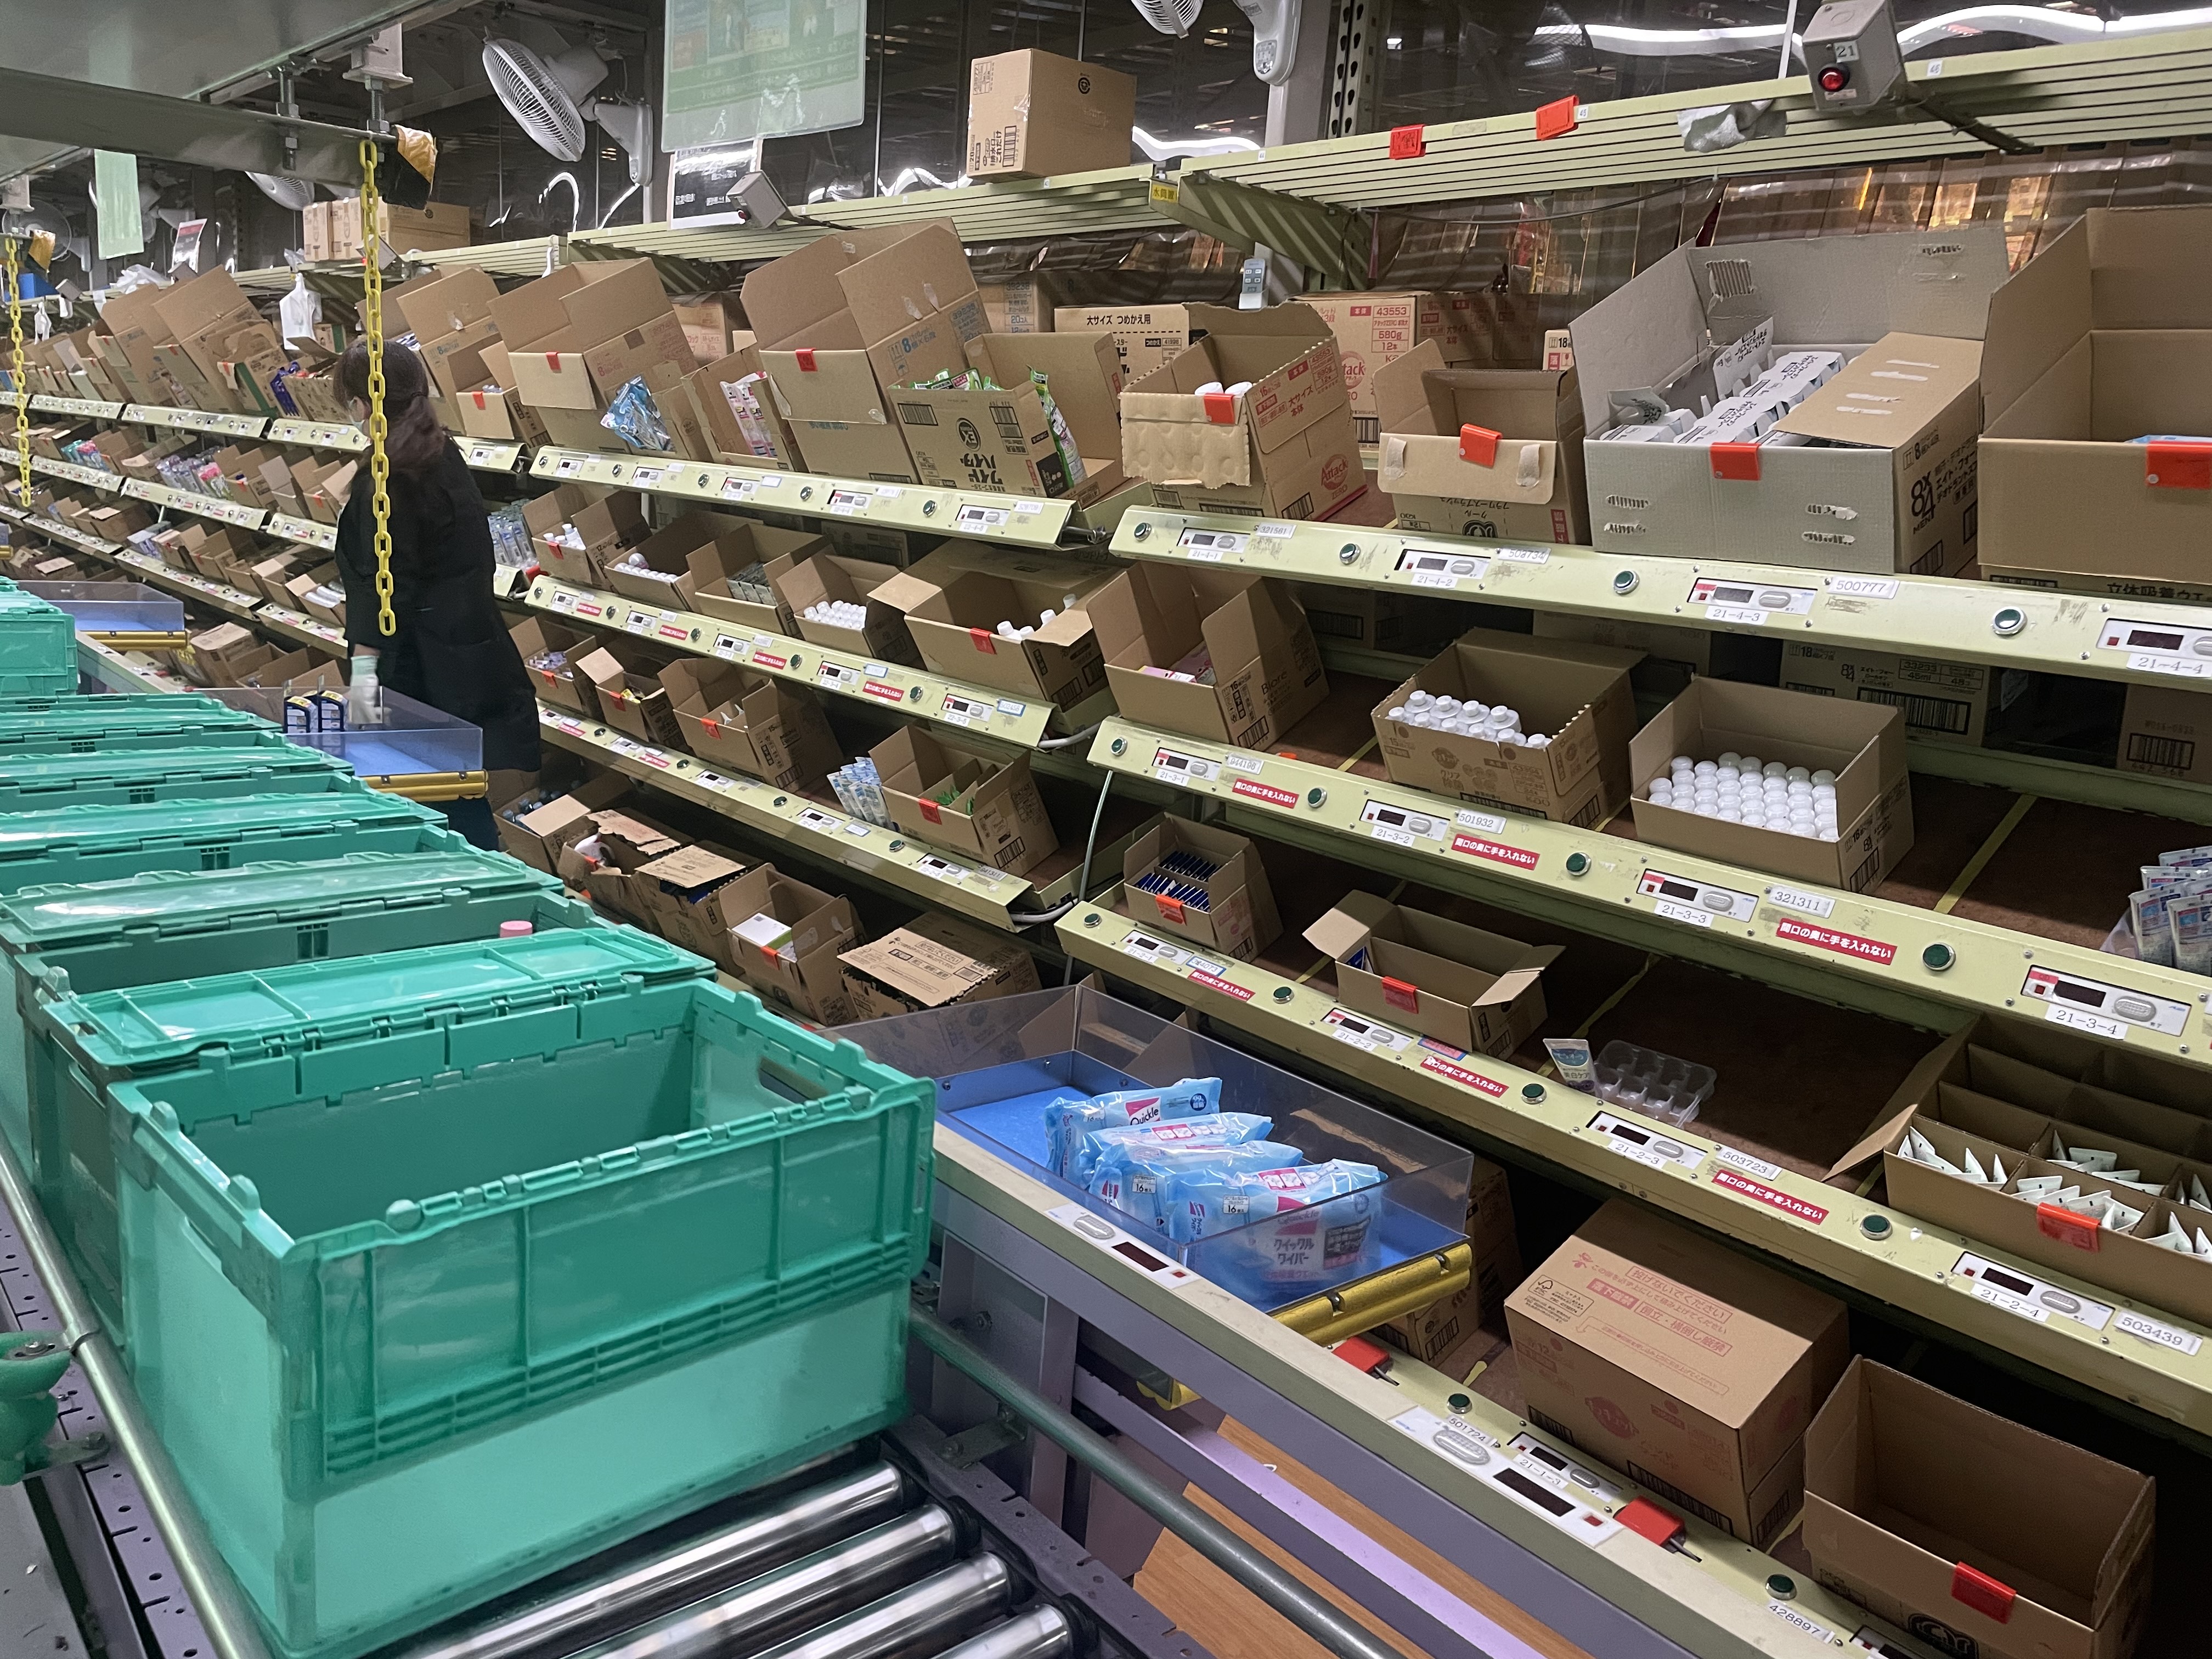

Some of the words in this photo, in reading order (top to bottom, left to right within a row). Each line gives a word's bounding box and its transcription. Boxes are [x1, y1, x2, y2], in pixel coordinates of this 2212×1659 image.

[1838, 46, 1854, 57] 21
[1579, 109, 1587, 117] 45
[969, 151, 974, 162] 20
[1153, 188, 1177, 200] 水筒置
[1376, 307, 1407, 315] 43553
[1087, 315, 1113, 325] 大サイズ
[1117, 314, 1151, 325] つめかえ用
[1379, 331, 1402, 340] 580g
[1558, 337, 1567, 348] 18
[901, 337, 912, 353] 8
[1381, 342, 1398, 351] 12本
[1312, 349, 1331, 363] 43553
[1385, 354, 1400, 363] Ka
[1260, 385, 1268, 397] 16
[1288, 385, 1314, 408] 大サイズ
[1290, 404, 1304, 416] 本体
[961, 430, 976, 443] EX
[1914, 442, 1921, 460] 8
[960, 454, 996, 469] ハイター
[968, 469, 1003, 484] ワイド
[1321, 459, 1348, 487] Attack
[1331, 484, 1348, 500] ZERO
[1464, 510, 1488, 519] クール
[1913, 516, 1931, 535] MEN
[1192, 550, 1218, 560] 21-4-1
[1417, 575, 1453, 586] 21-4-2
[1836, 580, 1887, 592] 500777
[1713, 609, 1759, 622] 21-4-3
[1801, 646, 1812, 658] 18
[1904, 661, 1937, 672] 33233
[2138, 657, 2204, 674] 21-4-4
[1230, 680, 1238, 691] 16
[768, 724, 776, 732] 15
[1160, 771, 1184, 783] 21-3-1
[1459, 813, 1494, 828] 501932
[1376, 828, 1410, 844] 21-3-2
[1454, 837, 1535, 865] 間口の奥に手を入れない
[1774, 891, 1820, 912] 321311
[1662, 904, 1707, 924] 21-3-3
[1780, 922, 1892, 959] 間口の奥に手を入れない
[1127, 948, 1153, 961] 21-2-1
[2056, 1010, 2118, 1035] 21-3-4
[1338, 1032, 1372, 1049] 21-2-2
[1130, 1107, 1159, 1126] Quickle
[1615, 1144, 1660, 1165] 21-2-3
[1723, 1151, 1768, 1173] 503723
[1717, 1172, 1822, 1220] 間口の奥に手を入れない
[1273, 1238, 1315, 1250] クイックル
[1278, 1252, 1309, 1266] ワイパー
[1590, 1279, 1638, 1307] 落下厳禁
[1630, 1269, 1726, 1319] 投げないでください
[1980, 1289, 2040, 1318] 21-2-4
[2122, 1317, 2183, 1346] 503439
[1449, 1418, 1486, 1442] 501724
[1519, 1459, 1561, 1486] 21-1-3
[1769, 1604, 1821, 1634] 428897
